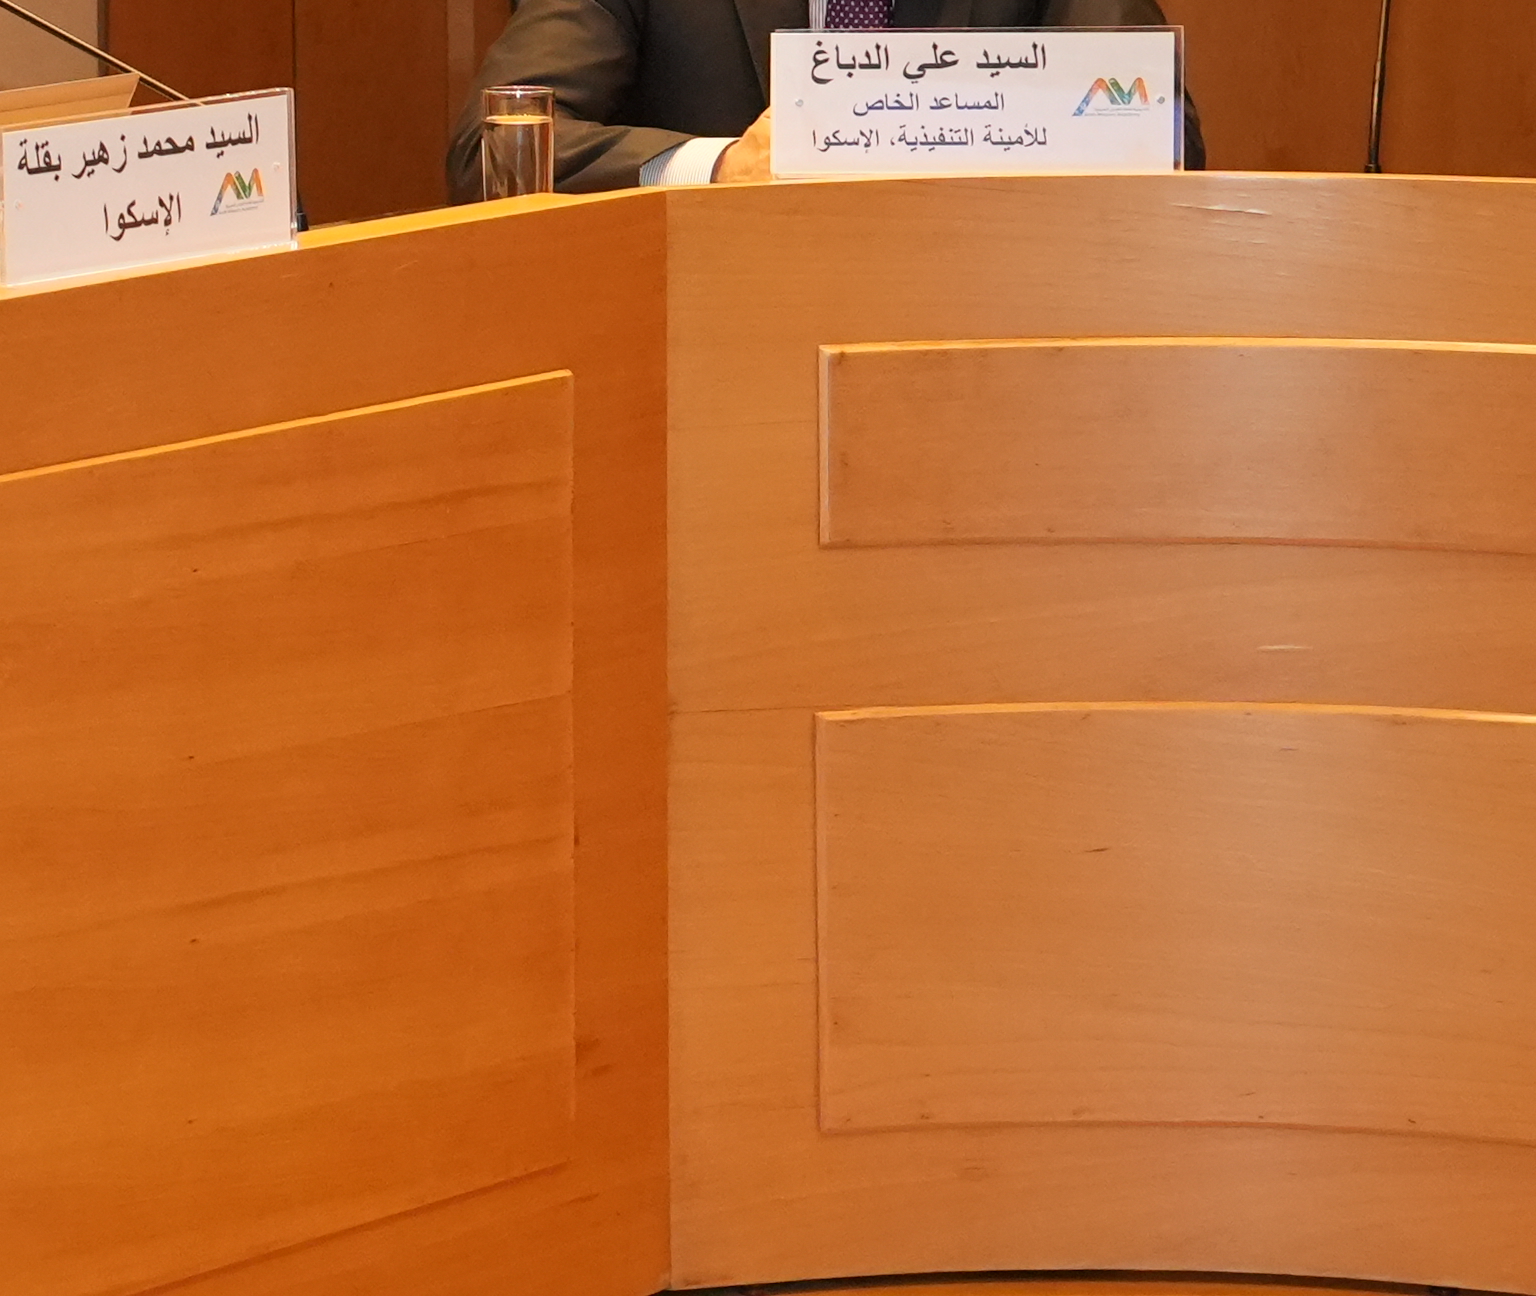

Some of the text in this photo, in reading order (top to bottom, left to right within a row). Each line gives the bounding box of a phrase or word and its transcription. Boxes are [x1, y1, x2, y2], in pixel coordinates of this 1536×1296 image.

[810, 43, 1048, 84] السيد علي الدباغ
[852, 90, 1006, 117] المساعد الخاص
[16, 113, 260, 181] السيد محمد زهير بقلة
[811, 127, 882, 154] الإسكوا
[981, 124, 1048, 150] للأمينة
[102, 194, 183, 241] الإسكوا
